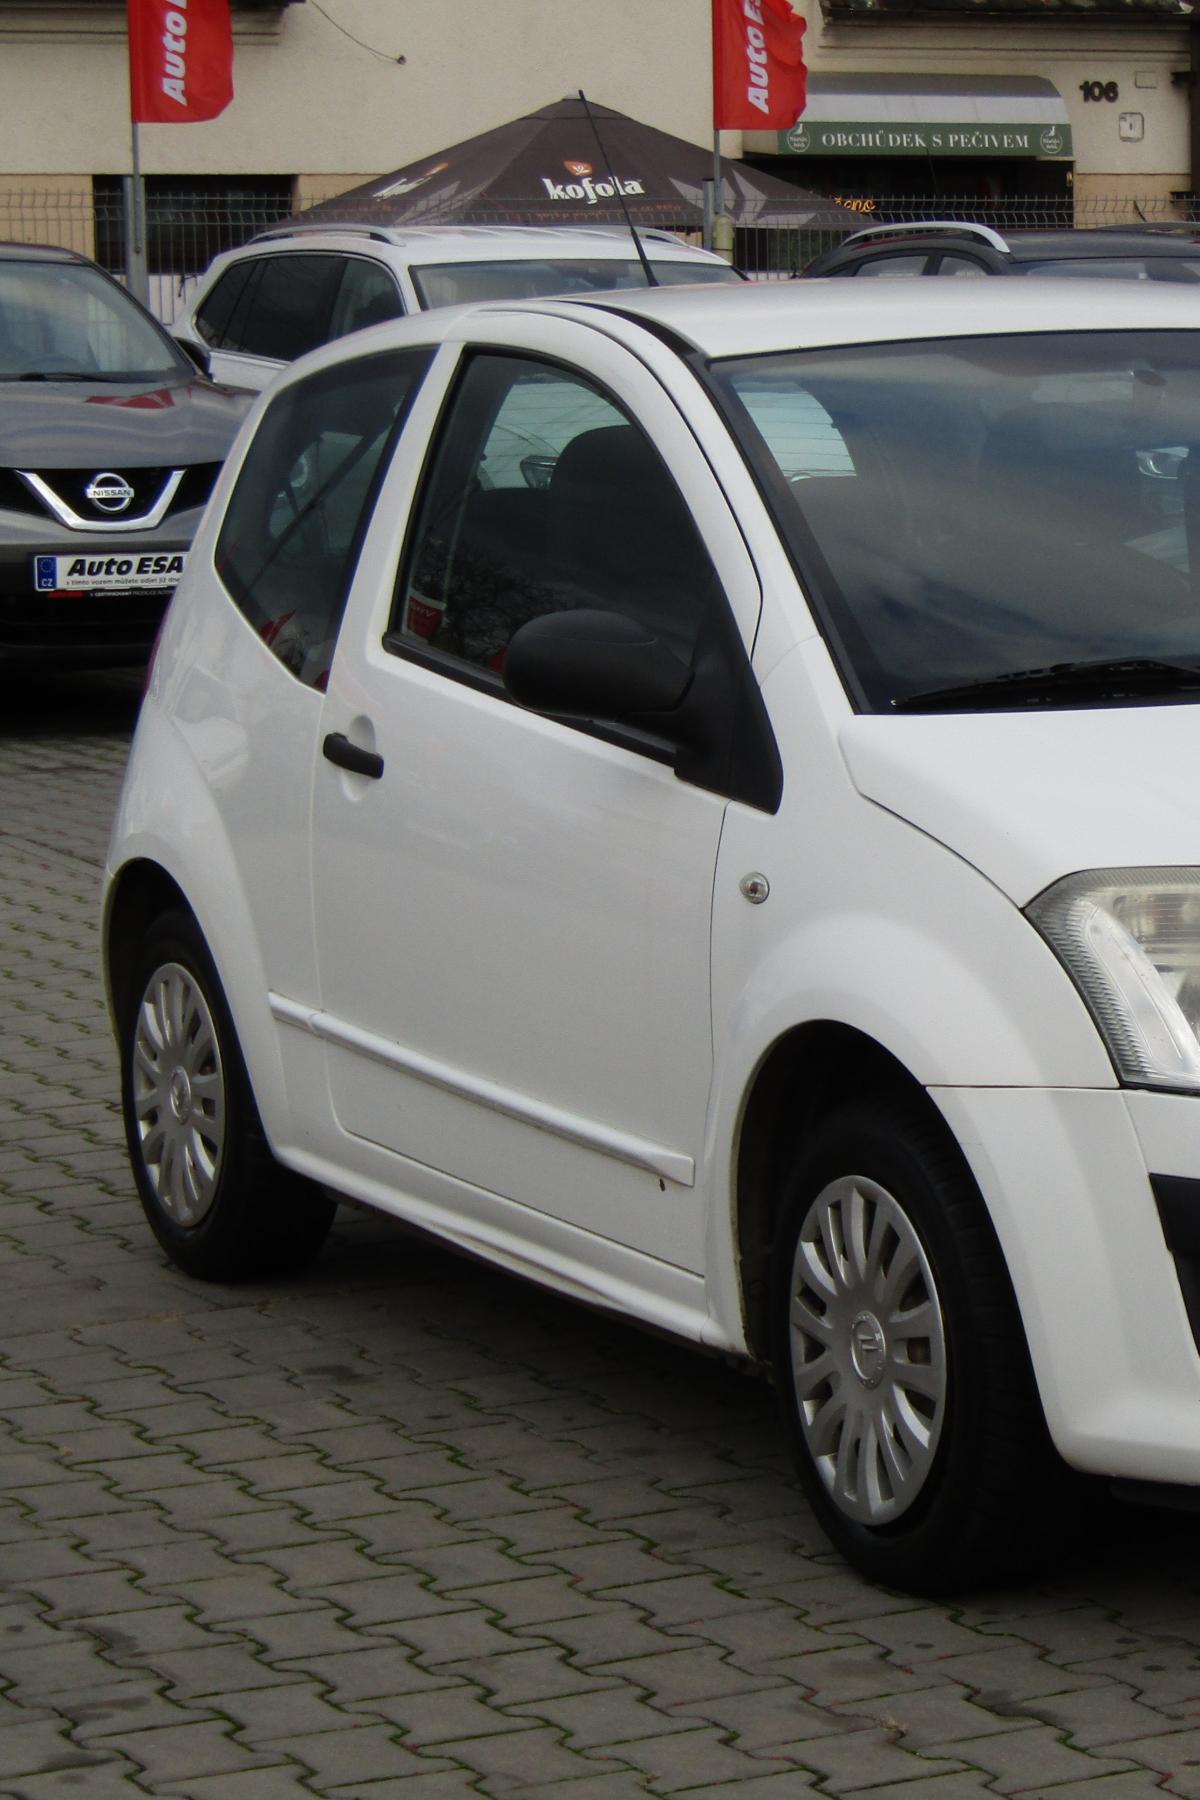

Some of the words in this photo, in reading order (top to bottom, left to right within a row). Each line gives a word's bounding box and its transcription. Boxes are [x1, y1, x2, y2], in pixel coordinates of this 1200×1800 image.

[162, 10, 187, 106] Auto
[747, 26, 769, 114] Auto
[1079, 80, 1119, 103] 106
[822, 130, 926, 147] OBCHŮDEK
[932, 134, 942, 147] S
[949, 131, 1029, 148] PEČIVEM
[542, 176, 645, 204] kofola
[92, 489, 131, 497] NISSAN
[67, 558, 133, 576] Auto
[135, 556, 183, 574] ESA
[41, 579, 53, 587] CZ
